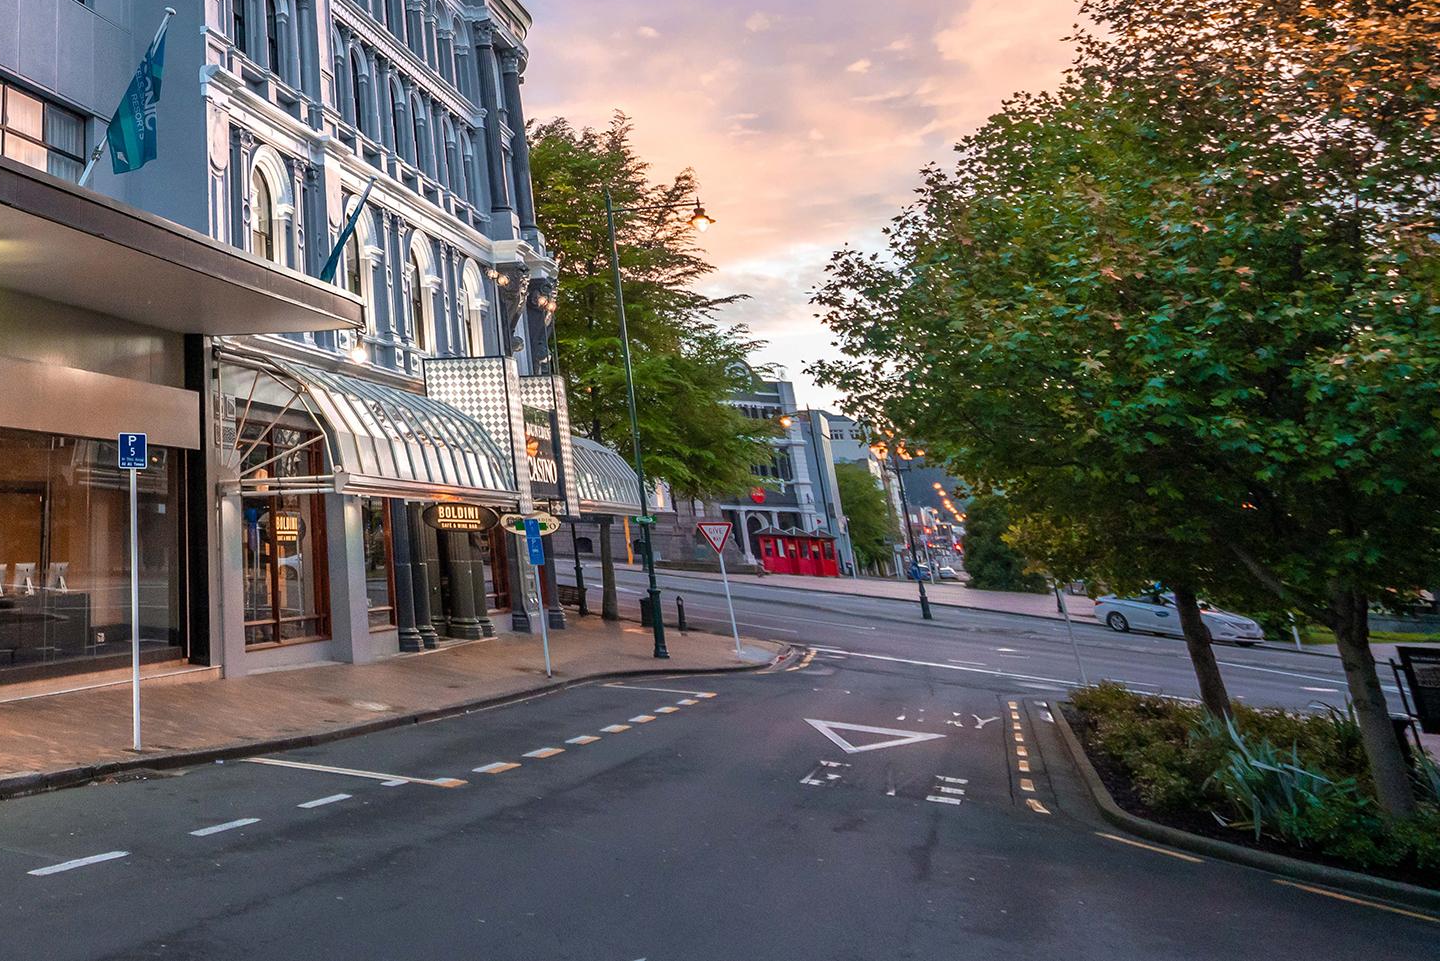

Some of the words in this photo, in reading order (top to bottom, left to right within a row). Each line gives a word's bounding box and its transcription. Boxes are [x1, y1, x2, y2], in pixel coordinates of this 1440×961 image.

[128, 436, 137, 446] P
[130, 447, 136, 456] 5
[527, 455, 558, 485] CASINO
[438, 506, 479, 520] BOLDINI
